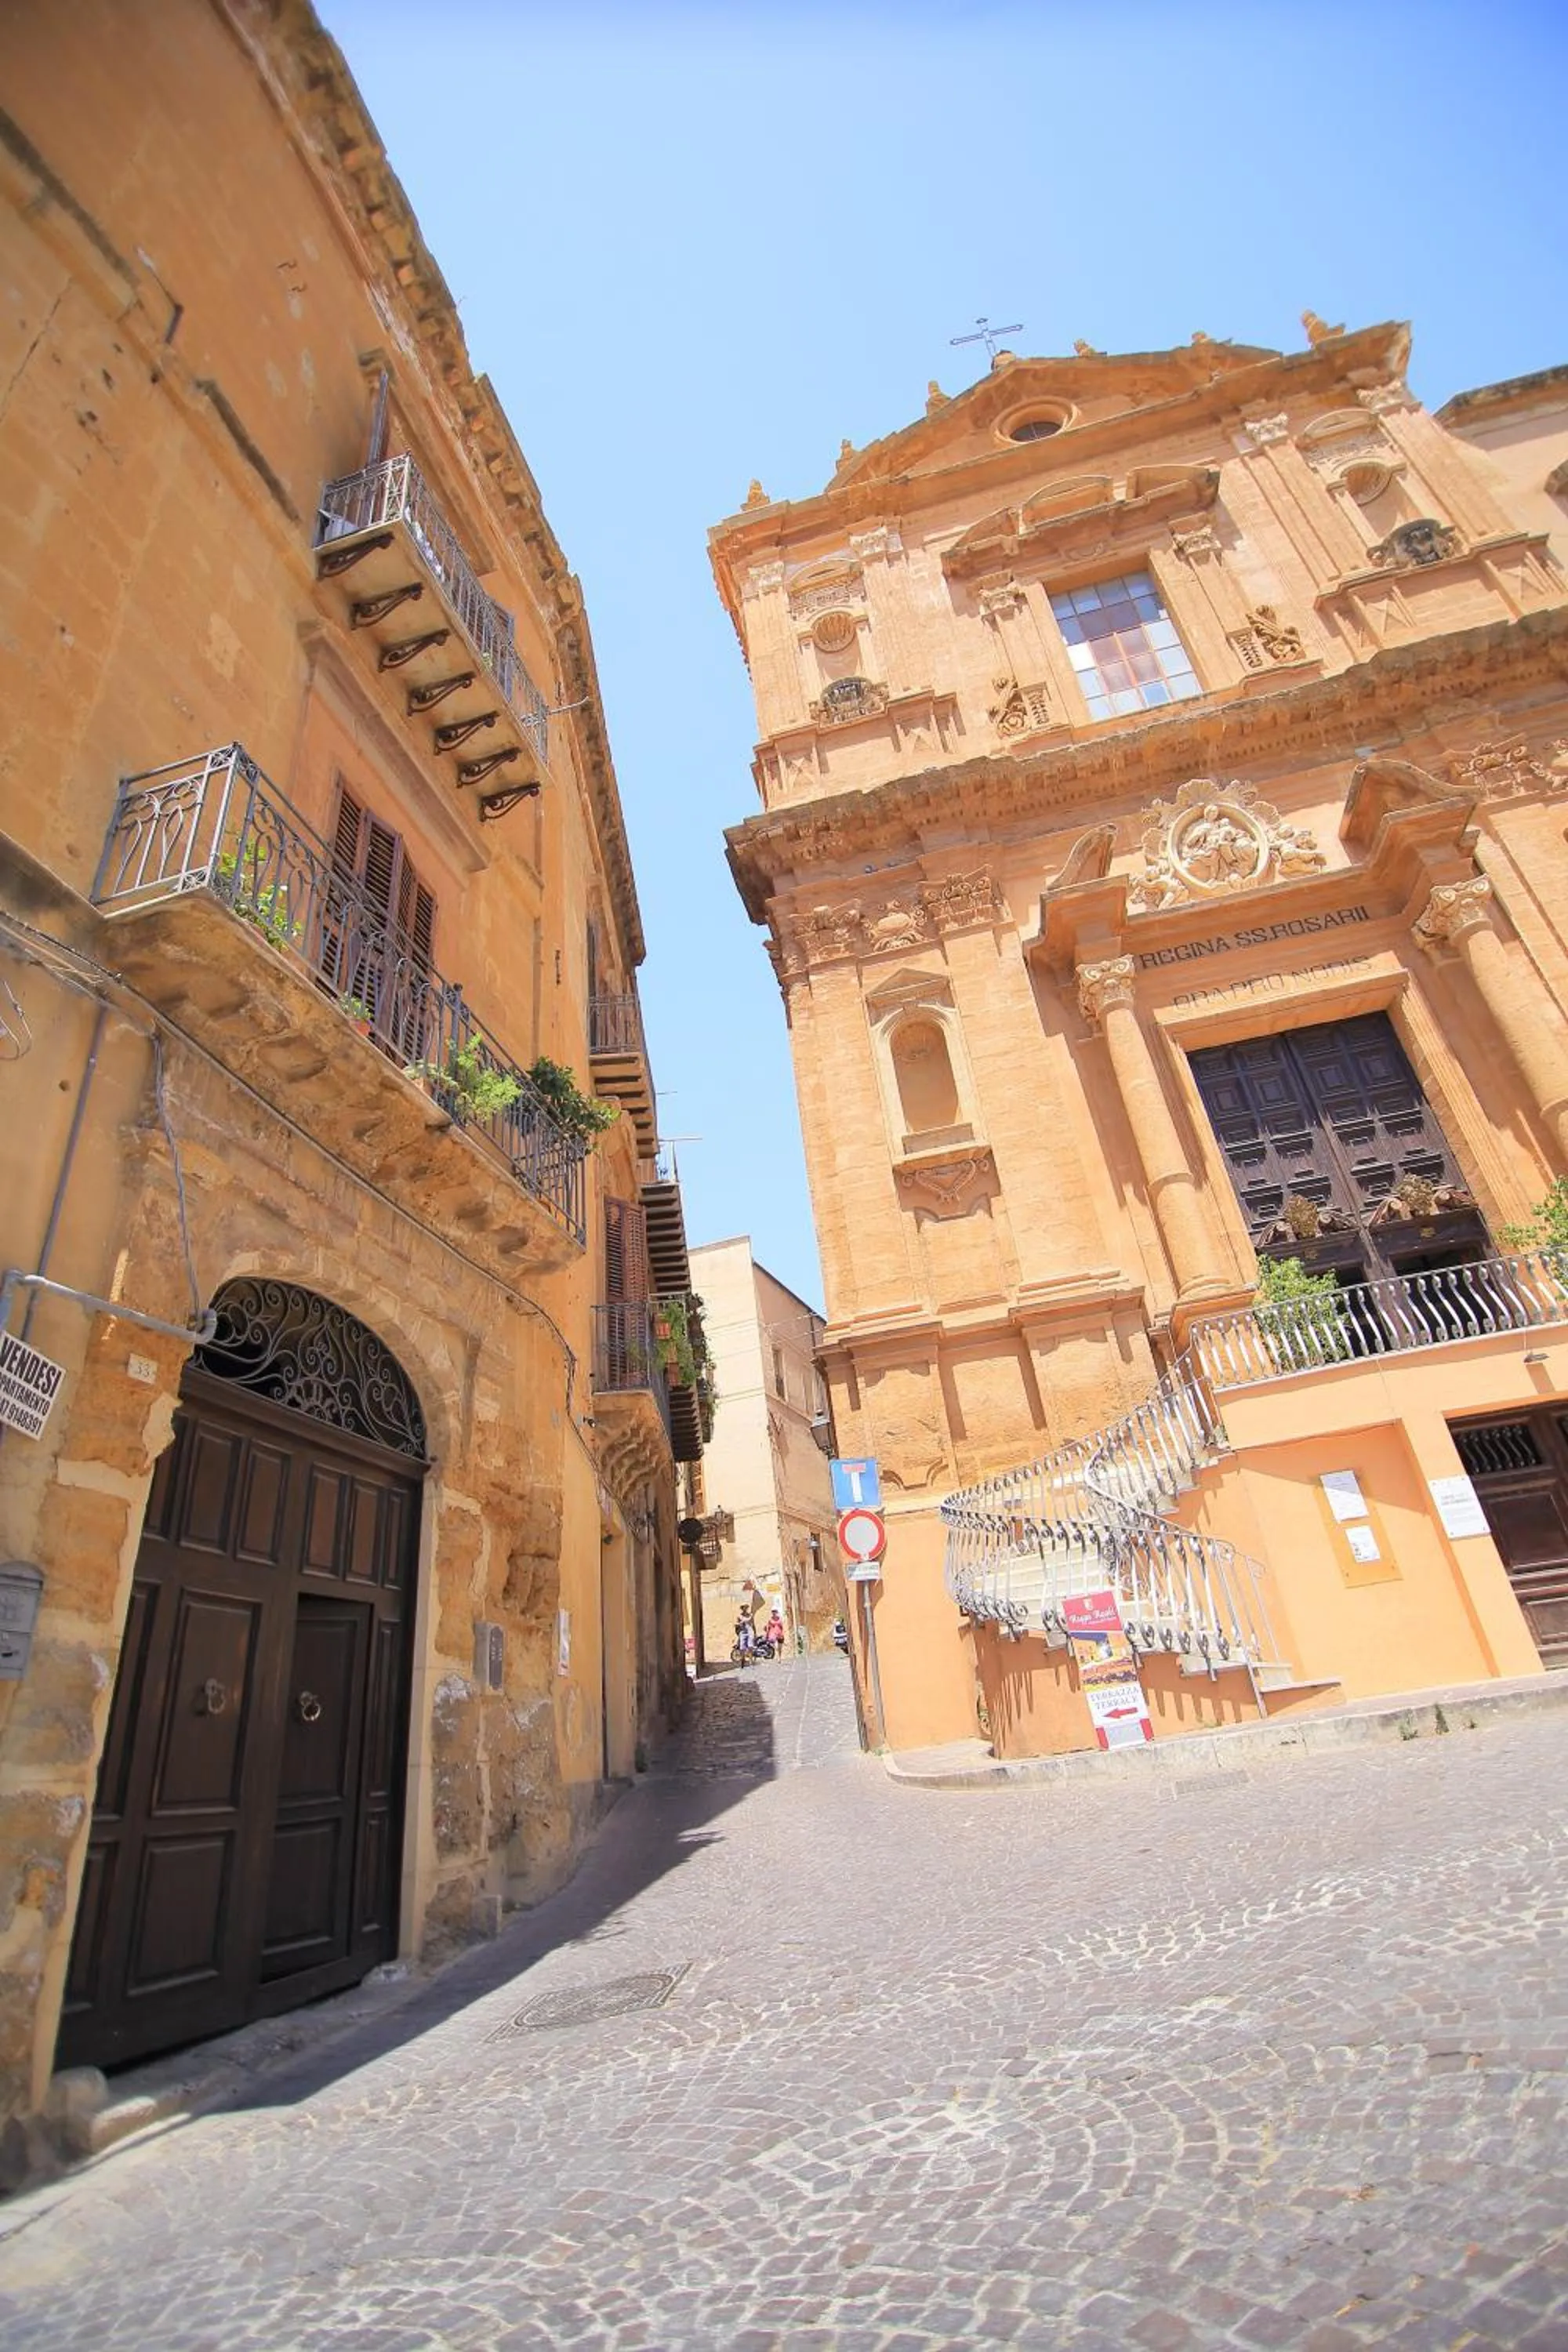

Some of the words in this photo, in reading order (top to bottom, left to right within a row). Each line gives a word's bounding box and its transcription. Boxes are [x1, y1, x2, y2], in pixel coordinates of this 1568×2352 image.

[1139, 937, 1230, 970] REGINA
[1229, 973, 1285, 1000] PRO
[0, 1335, 62, 1398] VENDESI
